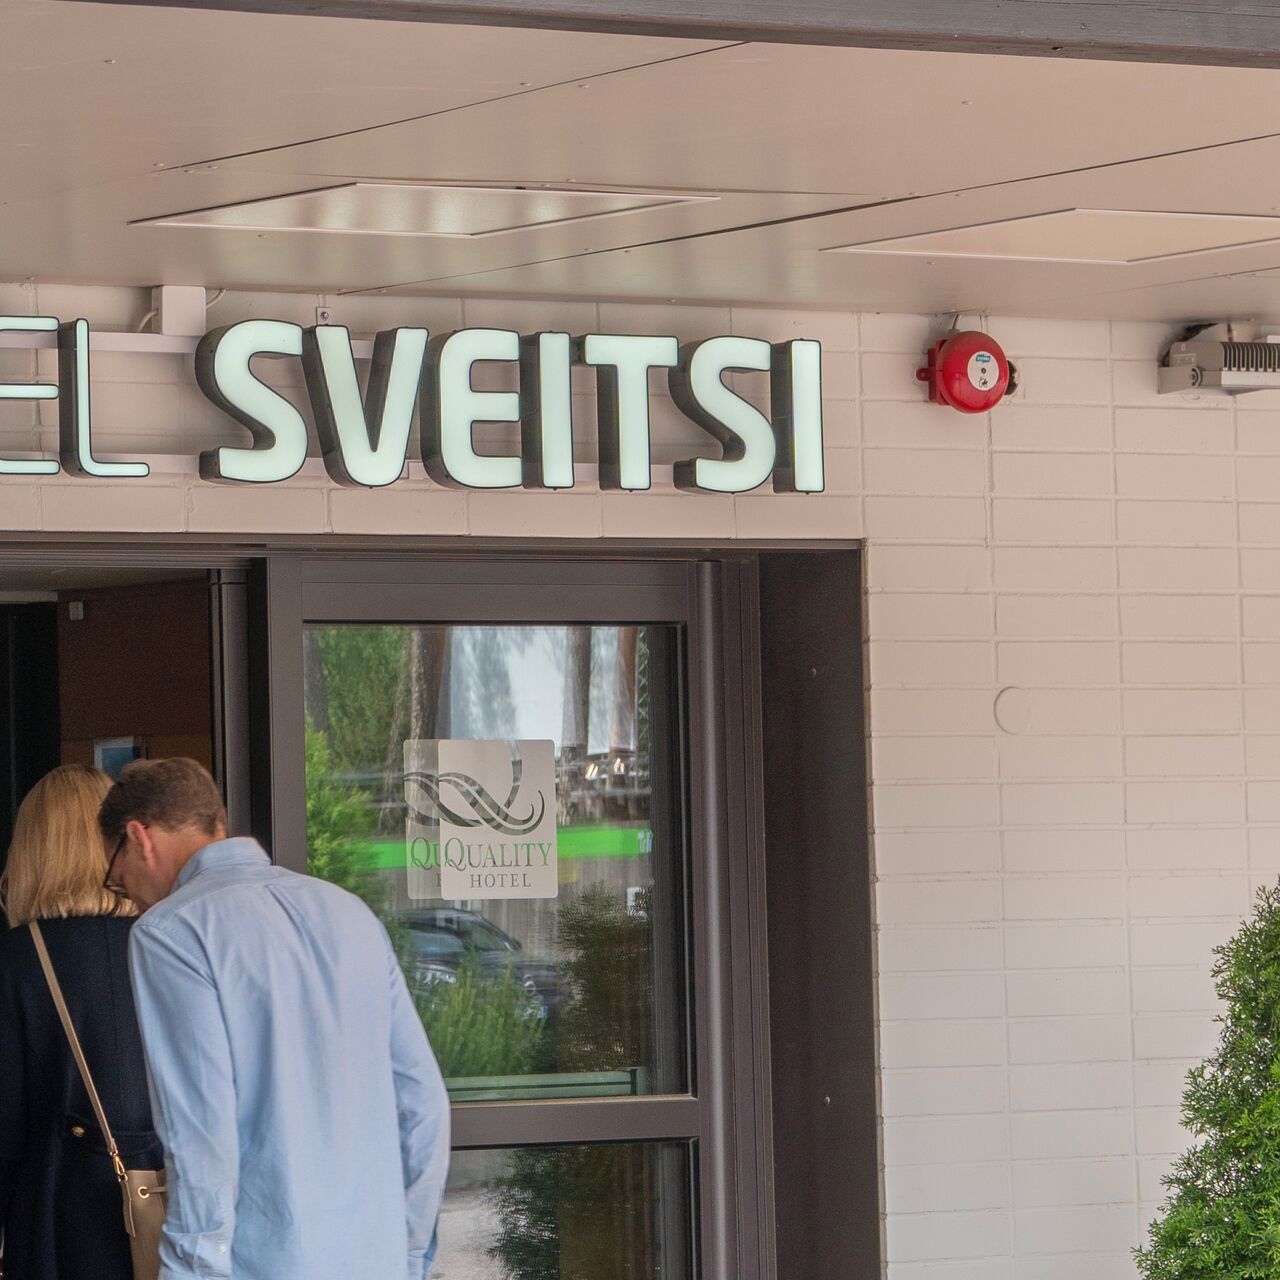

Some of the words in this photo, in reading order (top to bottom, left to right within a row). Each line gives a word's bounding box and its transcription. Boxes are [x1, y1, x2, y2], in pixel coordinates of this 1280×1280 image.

[195, 319, 826, 494] SVEITSI
[444, 836, 553, 871] QUALITY
[470, 872, 532, 889] HOTEL
